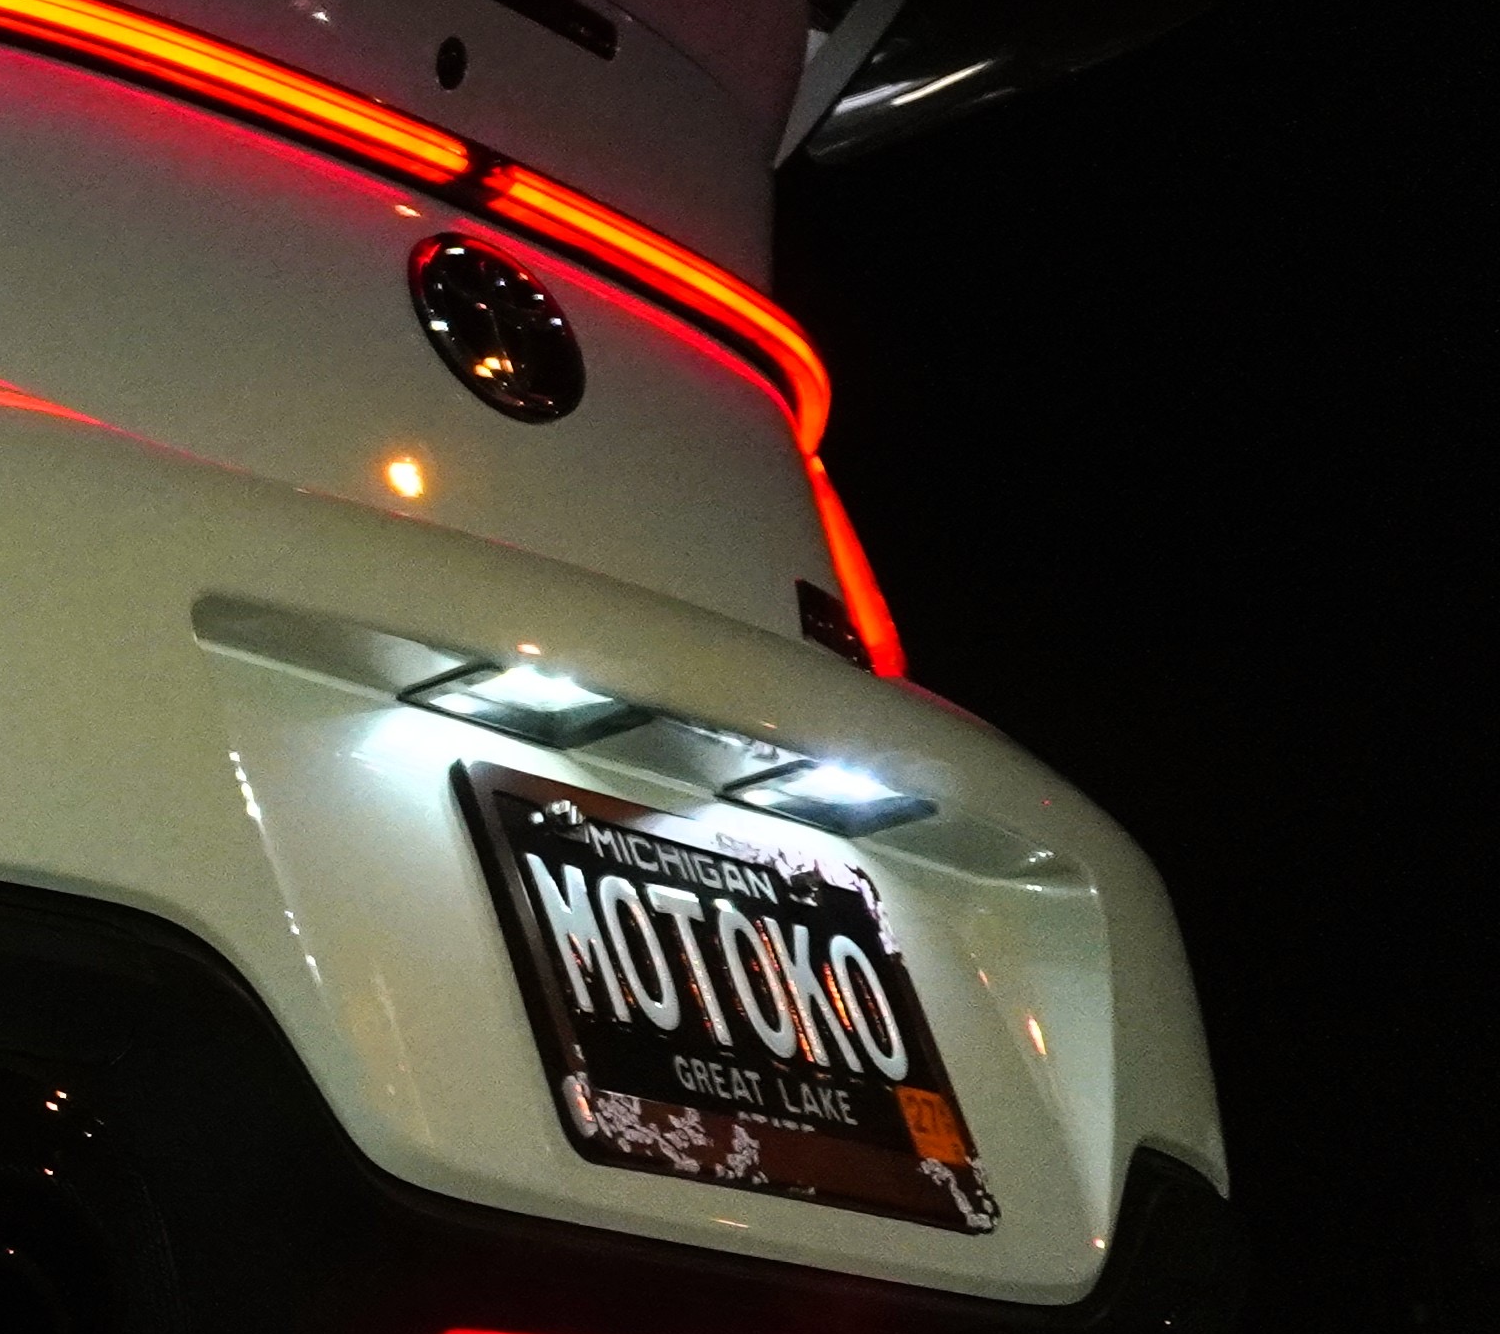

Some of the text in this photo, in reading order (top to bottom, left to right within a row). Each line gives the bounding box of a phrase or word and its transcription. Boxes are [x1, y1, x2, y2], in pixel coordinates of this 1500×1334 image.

[586, 825, 780, 905] MICHIGAN
[525, 853, 909, 1082] MOTOKO
[673, 1056, 762, 1105] GREAT
[782, 1079, 858, 1127] LAKE
